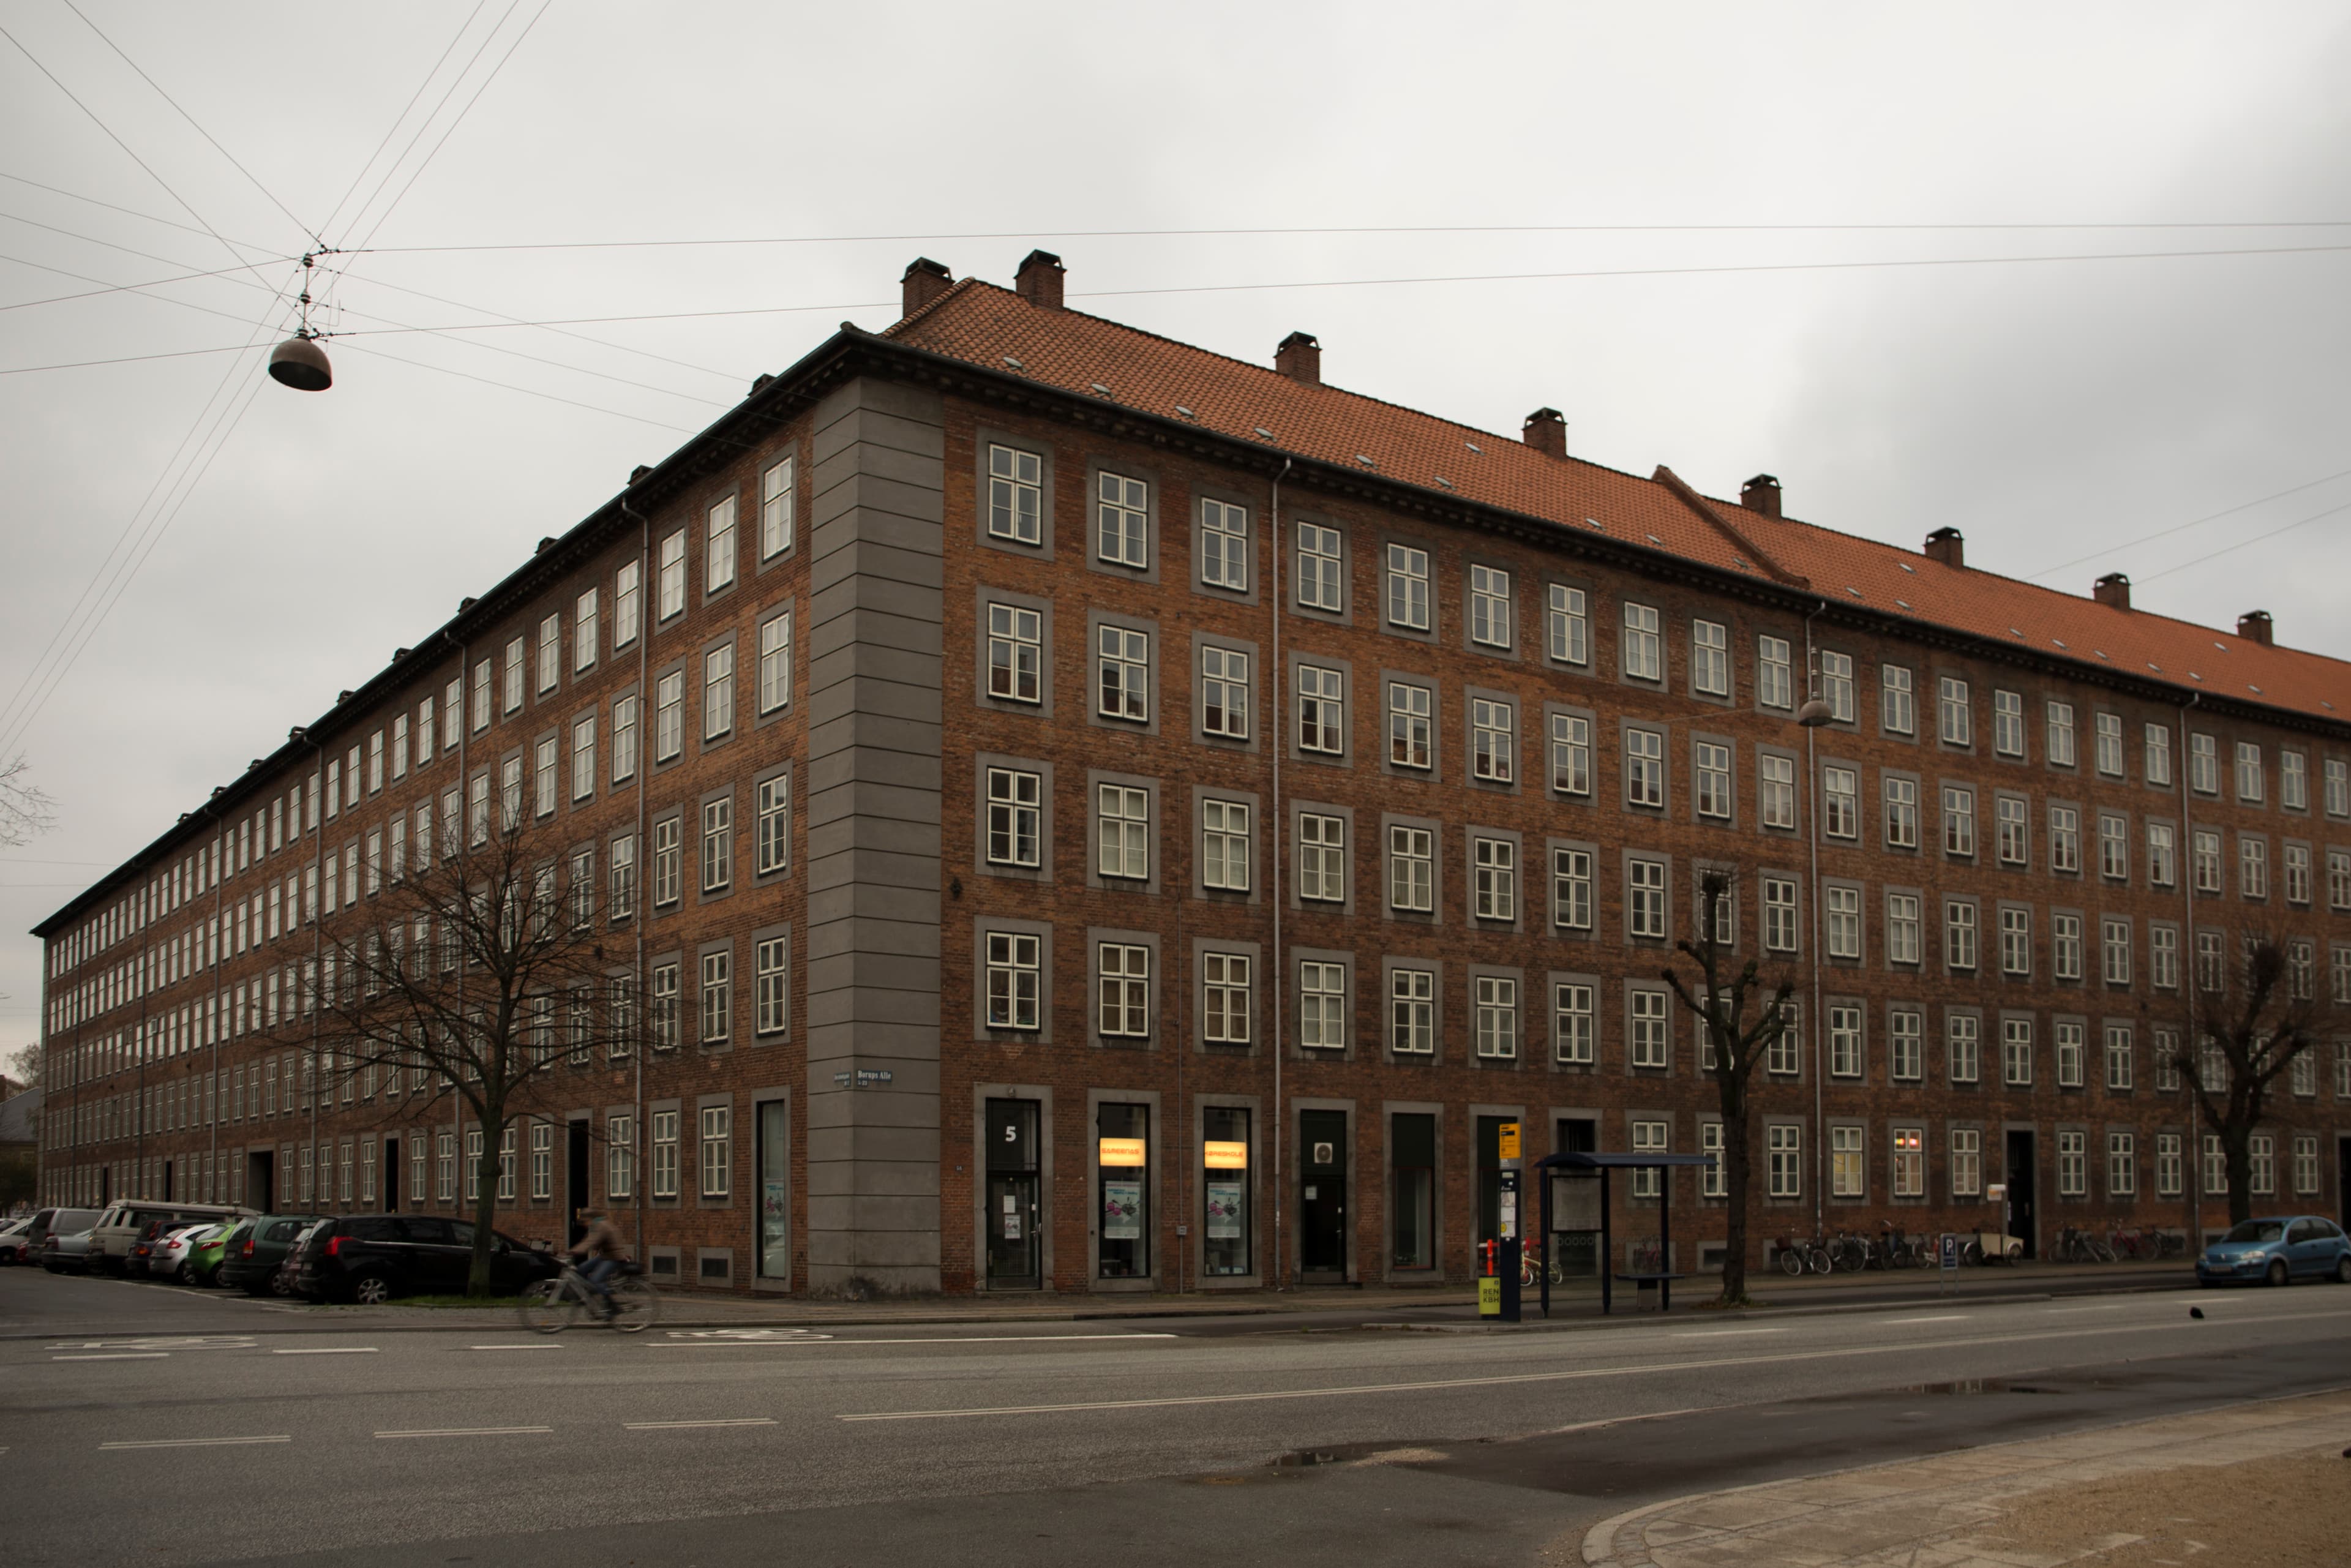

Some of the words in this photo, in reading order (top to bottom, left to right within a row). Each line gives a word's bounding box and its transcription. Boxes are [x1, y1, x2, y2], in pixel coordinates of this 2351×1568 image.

[858, 1070, 878, 1080] Borups
[1005, 1126, 1016, 1142] 5
[1946, 1239, 1953, 1254] P
